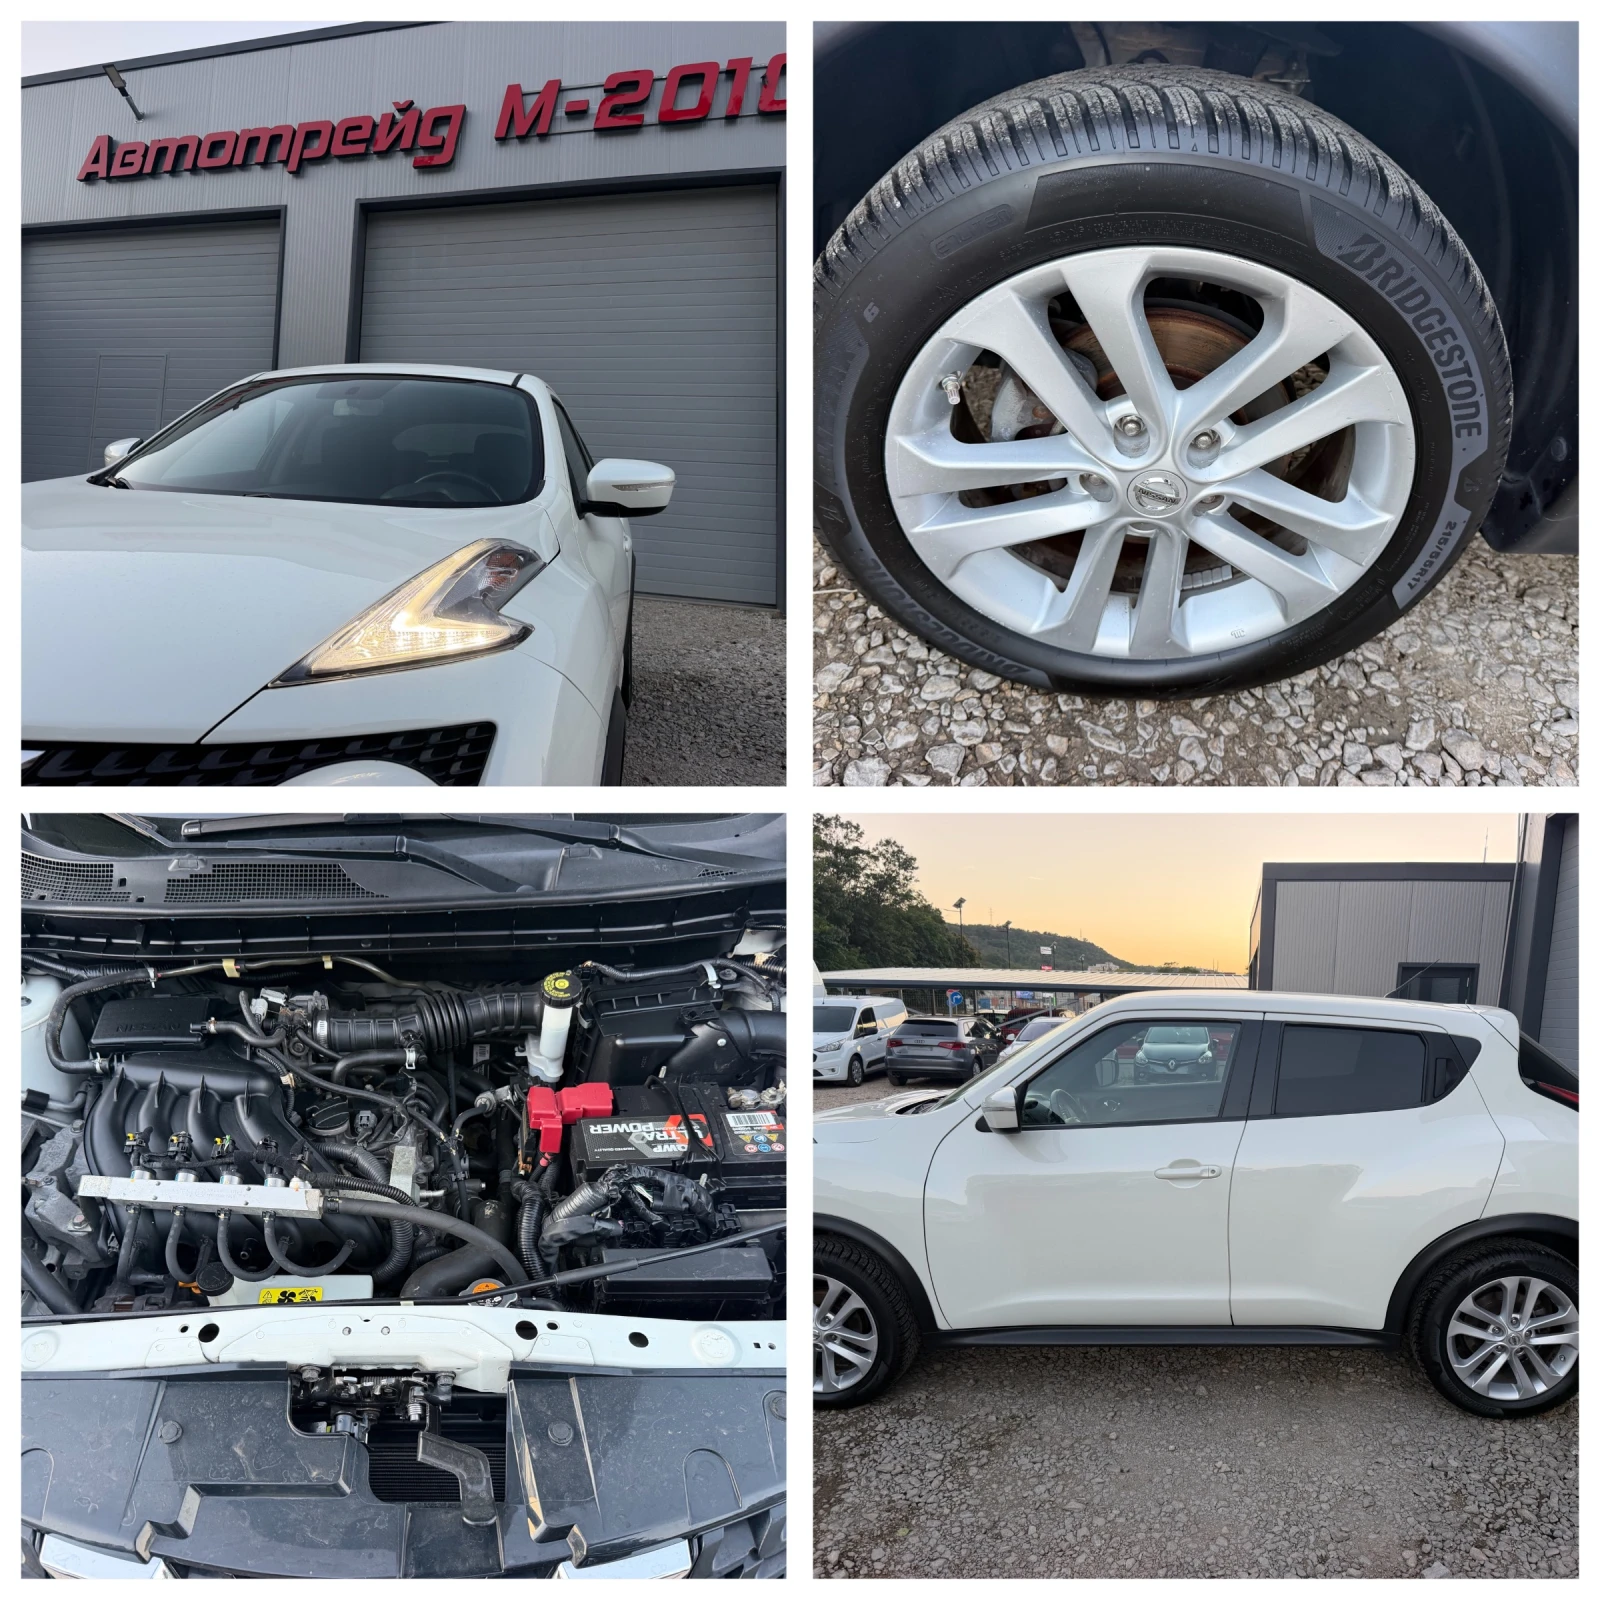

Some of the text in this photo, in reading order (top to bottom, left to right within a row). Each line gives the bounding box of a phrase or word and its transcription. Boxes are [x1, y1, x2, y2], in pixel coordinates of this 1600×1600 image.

[76, 99, 466, 181] Автотрейд
[1337, 233, 1482, 439] BRIDGESTONE
[1138, 488, 1176, 504] NISSAN
[1407, 520, 1457, 590] 215/55R17
[116, 1023, 181, 1033] NISSAN
[590, 1122, 655, 1134] POWER
